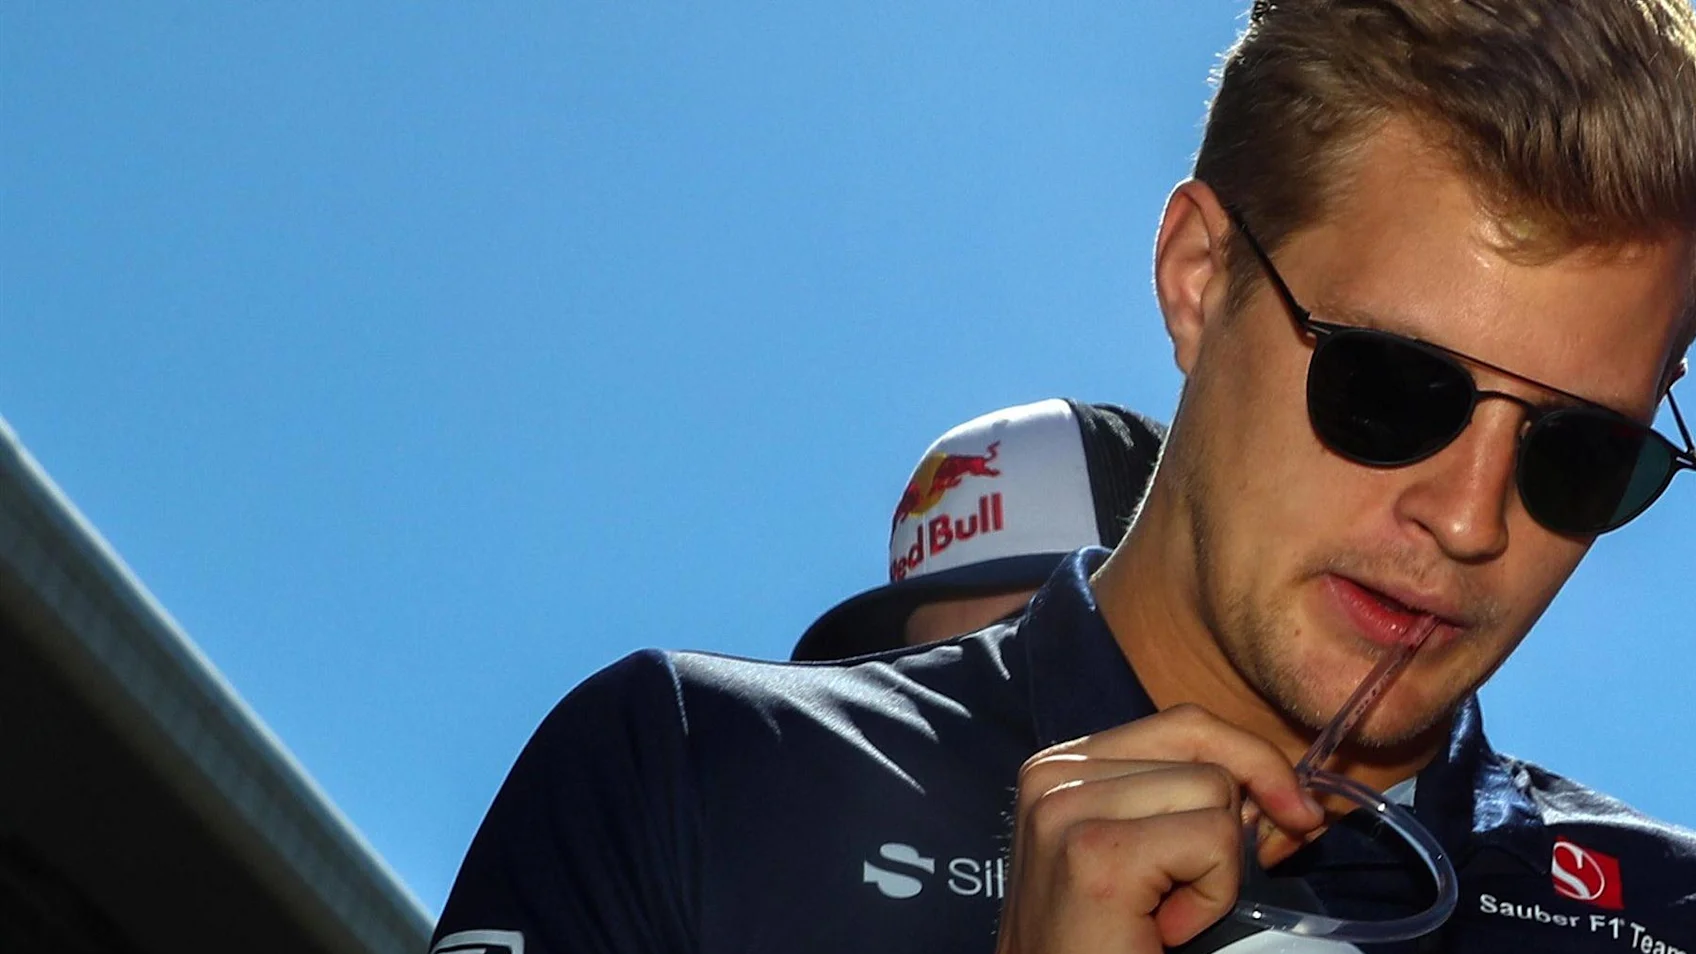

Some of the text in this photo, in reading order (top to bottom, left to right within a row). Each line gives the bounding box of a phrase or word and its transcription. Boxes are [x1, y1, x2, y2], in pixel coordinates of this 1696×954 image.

[928, 494, 1005, 556] Bull
[948, 858, 1004, 899] Sil
[1479, 893, 1581, 928] Sauber
[1589, 914, 1620, 940] F1
